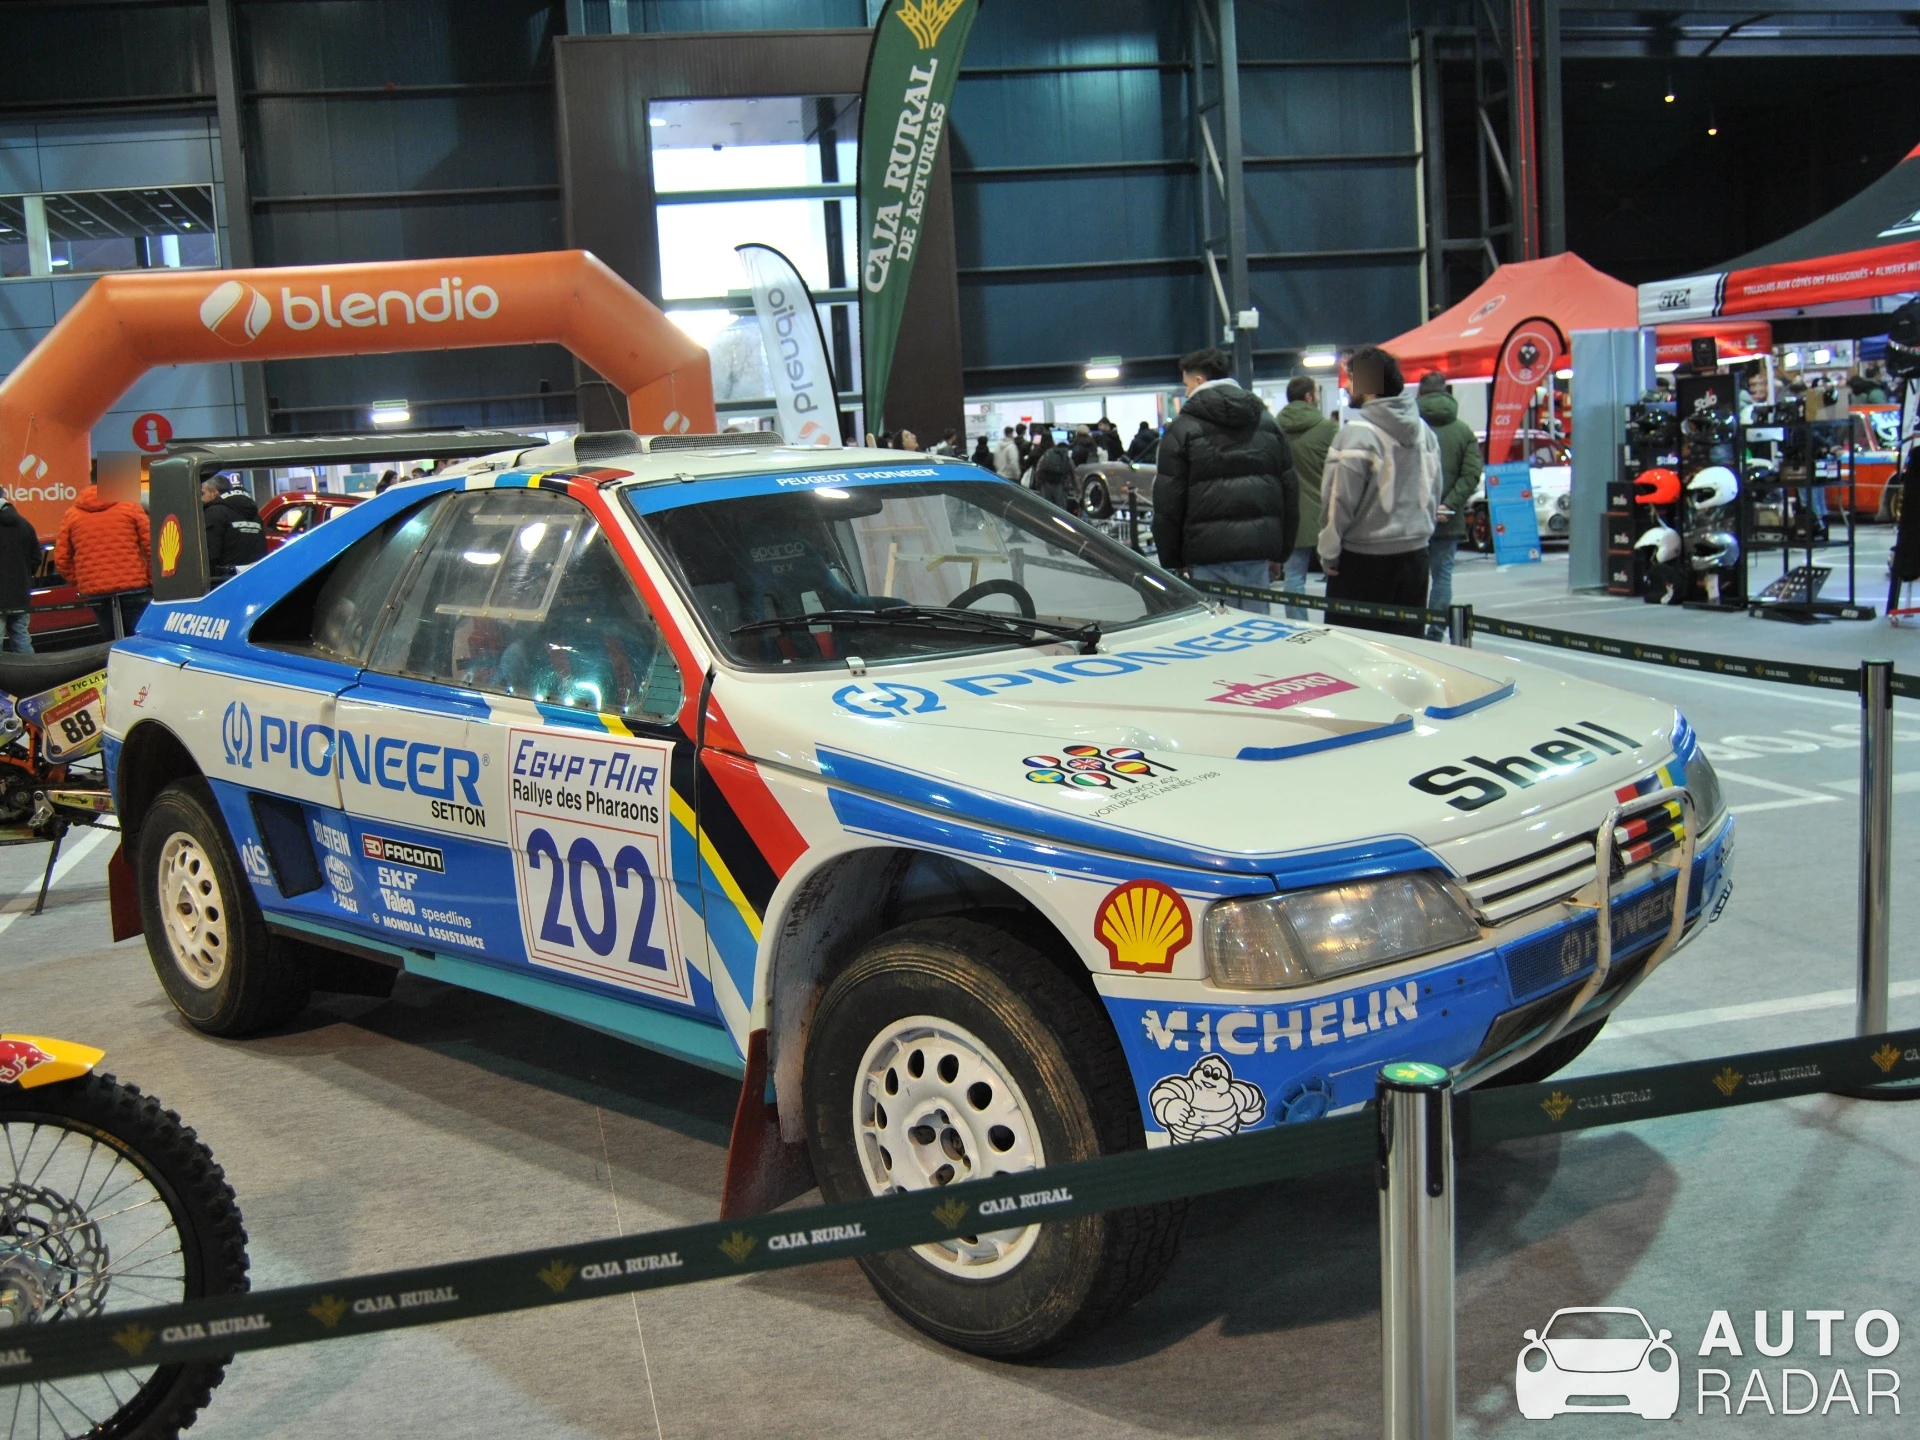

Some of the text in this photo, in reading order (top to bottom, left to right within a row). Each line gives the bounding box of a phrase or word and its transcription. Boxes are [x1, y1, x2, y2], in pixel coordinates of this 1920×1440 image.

[865, 57, 938, 294] CAJA RURAL
[897, 102, 946, 262] DE ASTURIAS
[1874, 261, 1906, 278] ALWAYS
[281, 277, 499, 331] blendio
[776, 467, 940, 488] PEUGEOT PIONEER
[163, 611, 230, 641] MICHELIN
[941, 618, 1312, 696] PIONEER
[71, 680, 88, 691] TYC
[89, 676, 100, 684] LA
[1225, 674, 1339, 705] KHODRO
[60, 709, 97, 744] 88
[260, 715, 484, 808] PIONEER
[1408, 720, 1644, 812] Shell
[513, 778, 660, 825] Rallye des Pharaons
[1089, 797, 1138, 819] VOITURE
[1135, 792, 1153, 802] DE
[1109, 781, 1159, 801] PEUGEOT
[430, 800, 486, 828] SETTON
[384, 842, 443, 869] FACOM
[378, 866, 418, 891] SKF
[380, 887, 416, 916] Valeo
[525, 827, 668, 972] 202
[383, 915, 486, 950] MONDIAL ASSISTANCE
[421, 906, 472, 929] speedline
[1141, 980, 1418, 1055] MICHELIN
[978, 1187, 1073, 1217] CAJA RURAL
[767, 1222, 866, 1251] CAJA RURAL
[580, 1251, 683, 1282] CAJA RURAL
[353, 1285, 459, 1315] CAJA RURAL
[160, 1314, 272, 1344] CAJA RURAL
